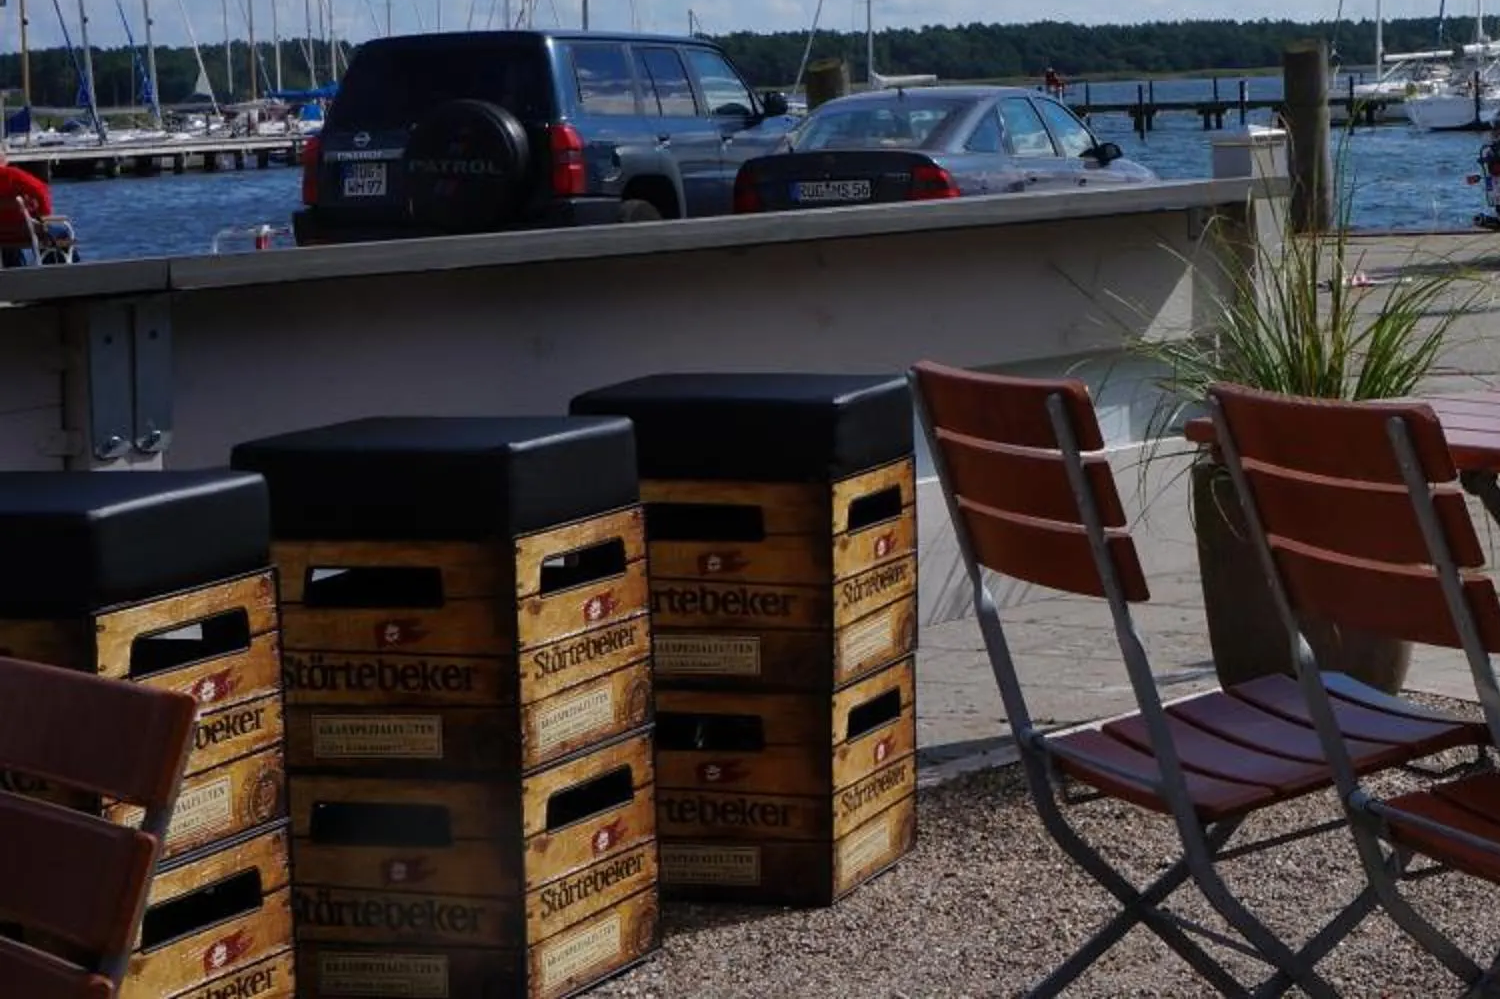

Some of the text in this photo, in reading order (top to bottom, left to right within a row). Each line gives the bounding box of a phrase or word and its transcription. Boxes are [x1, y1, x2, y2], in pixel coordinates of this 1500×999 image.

[408, 158, 504, 176] PATROL
[652, 586, 796, 617] rtebeker
[533, 623, 638, 680] Störtebeker
[662, 794, 797, 828] tebeker
[540, 853, 644, 919] Störtebeker
